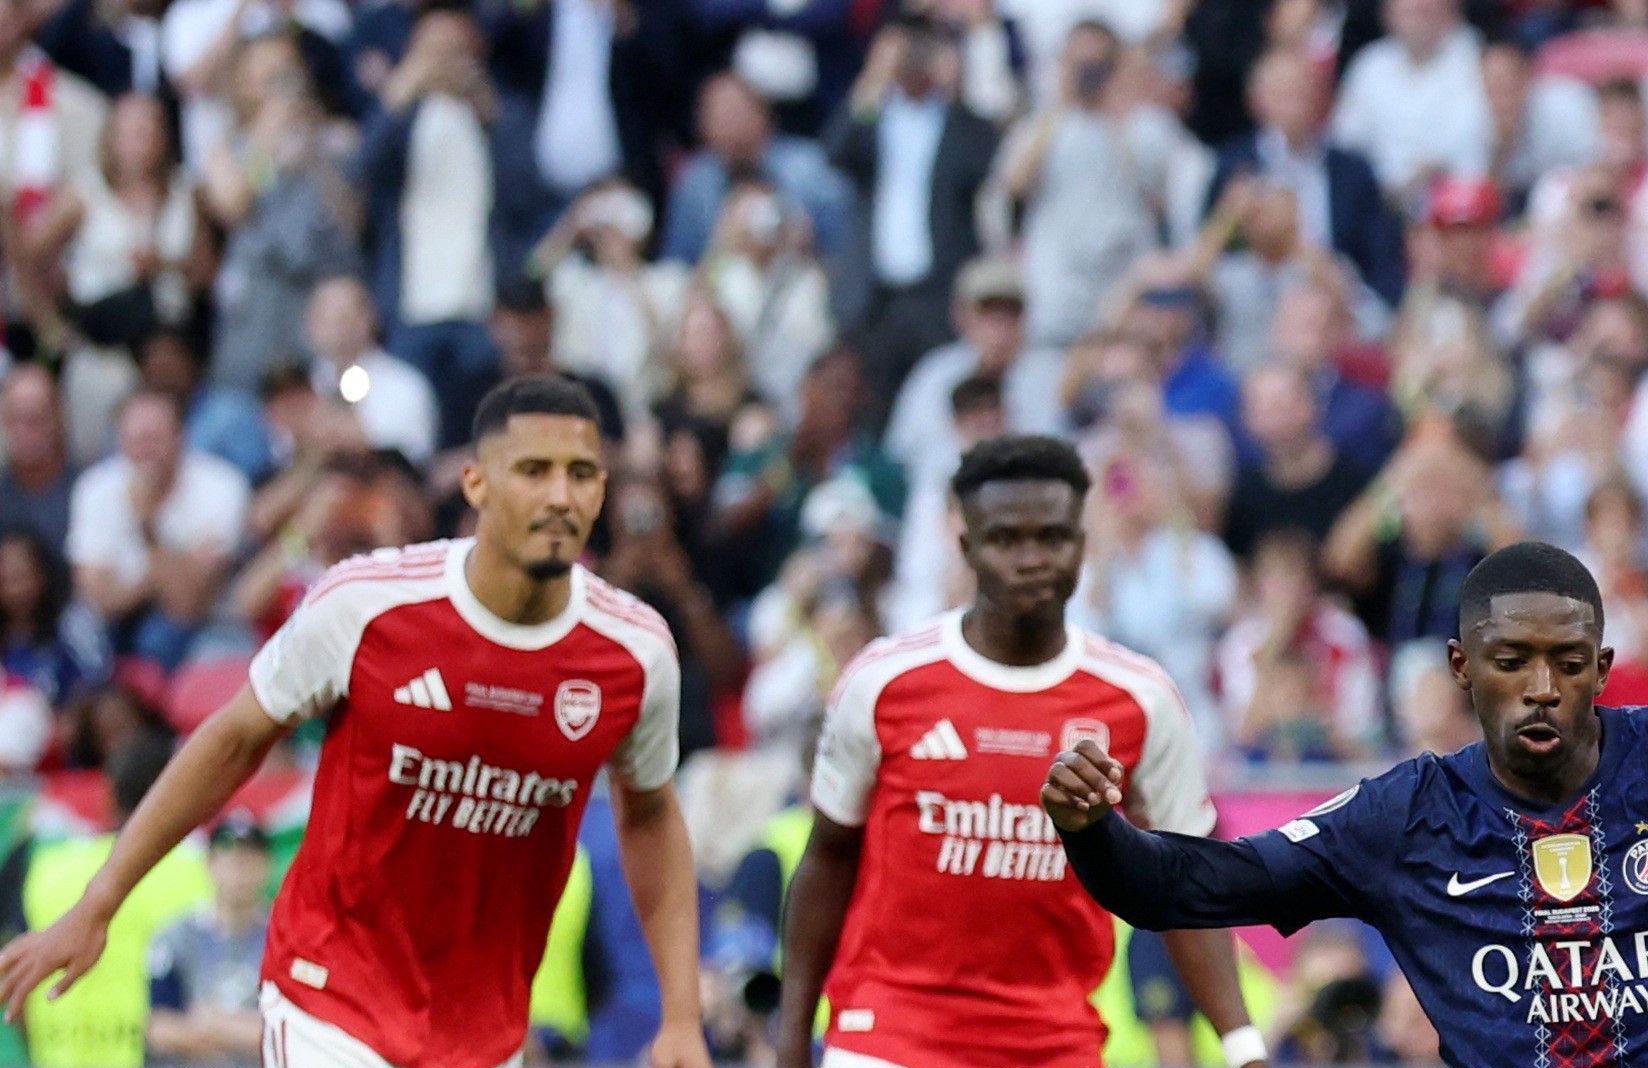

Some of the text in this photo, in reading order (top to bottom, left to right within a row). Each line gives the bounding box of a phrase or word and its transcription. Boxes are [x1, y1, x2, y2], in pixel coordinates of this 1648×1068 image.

[405, 788, 453, 825] FLY
[915, 789, 1058, 843] Emira
[936, 836, 983, 876] FLY
